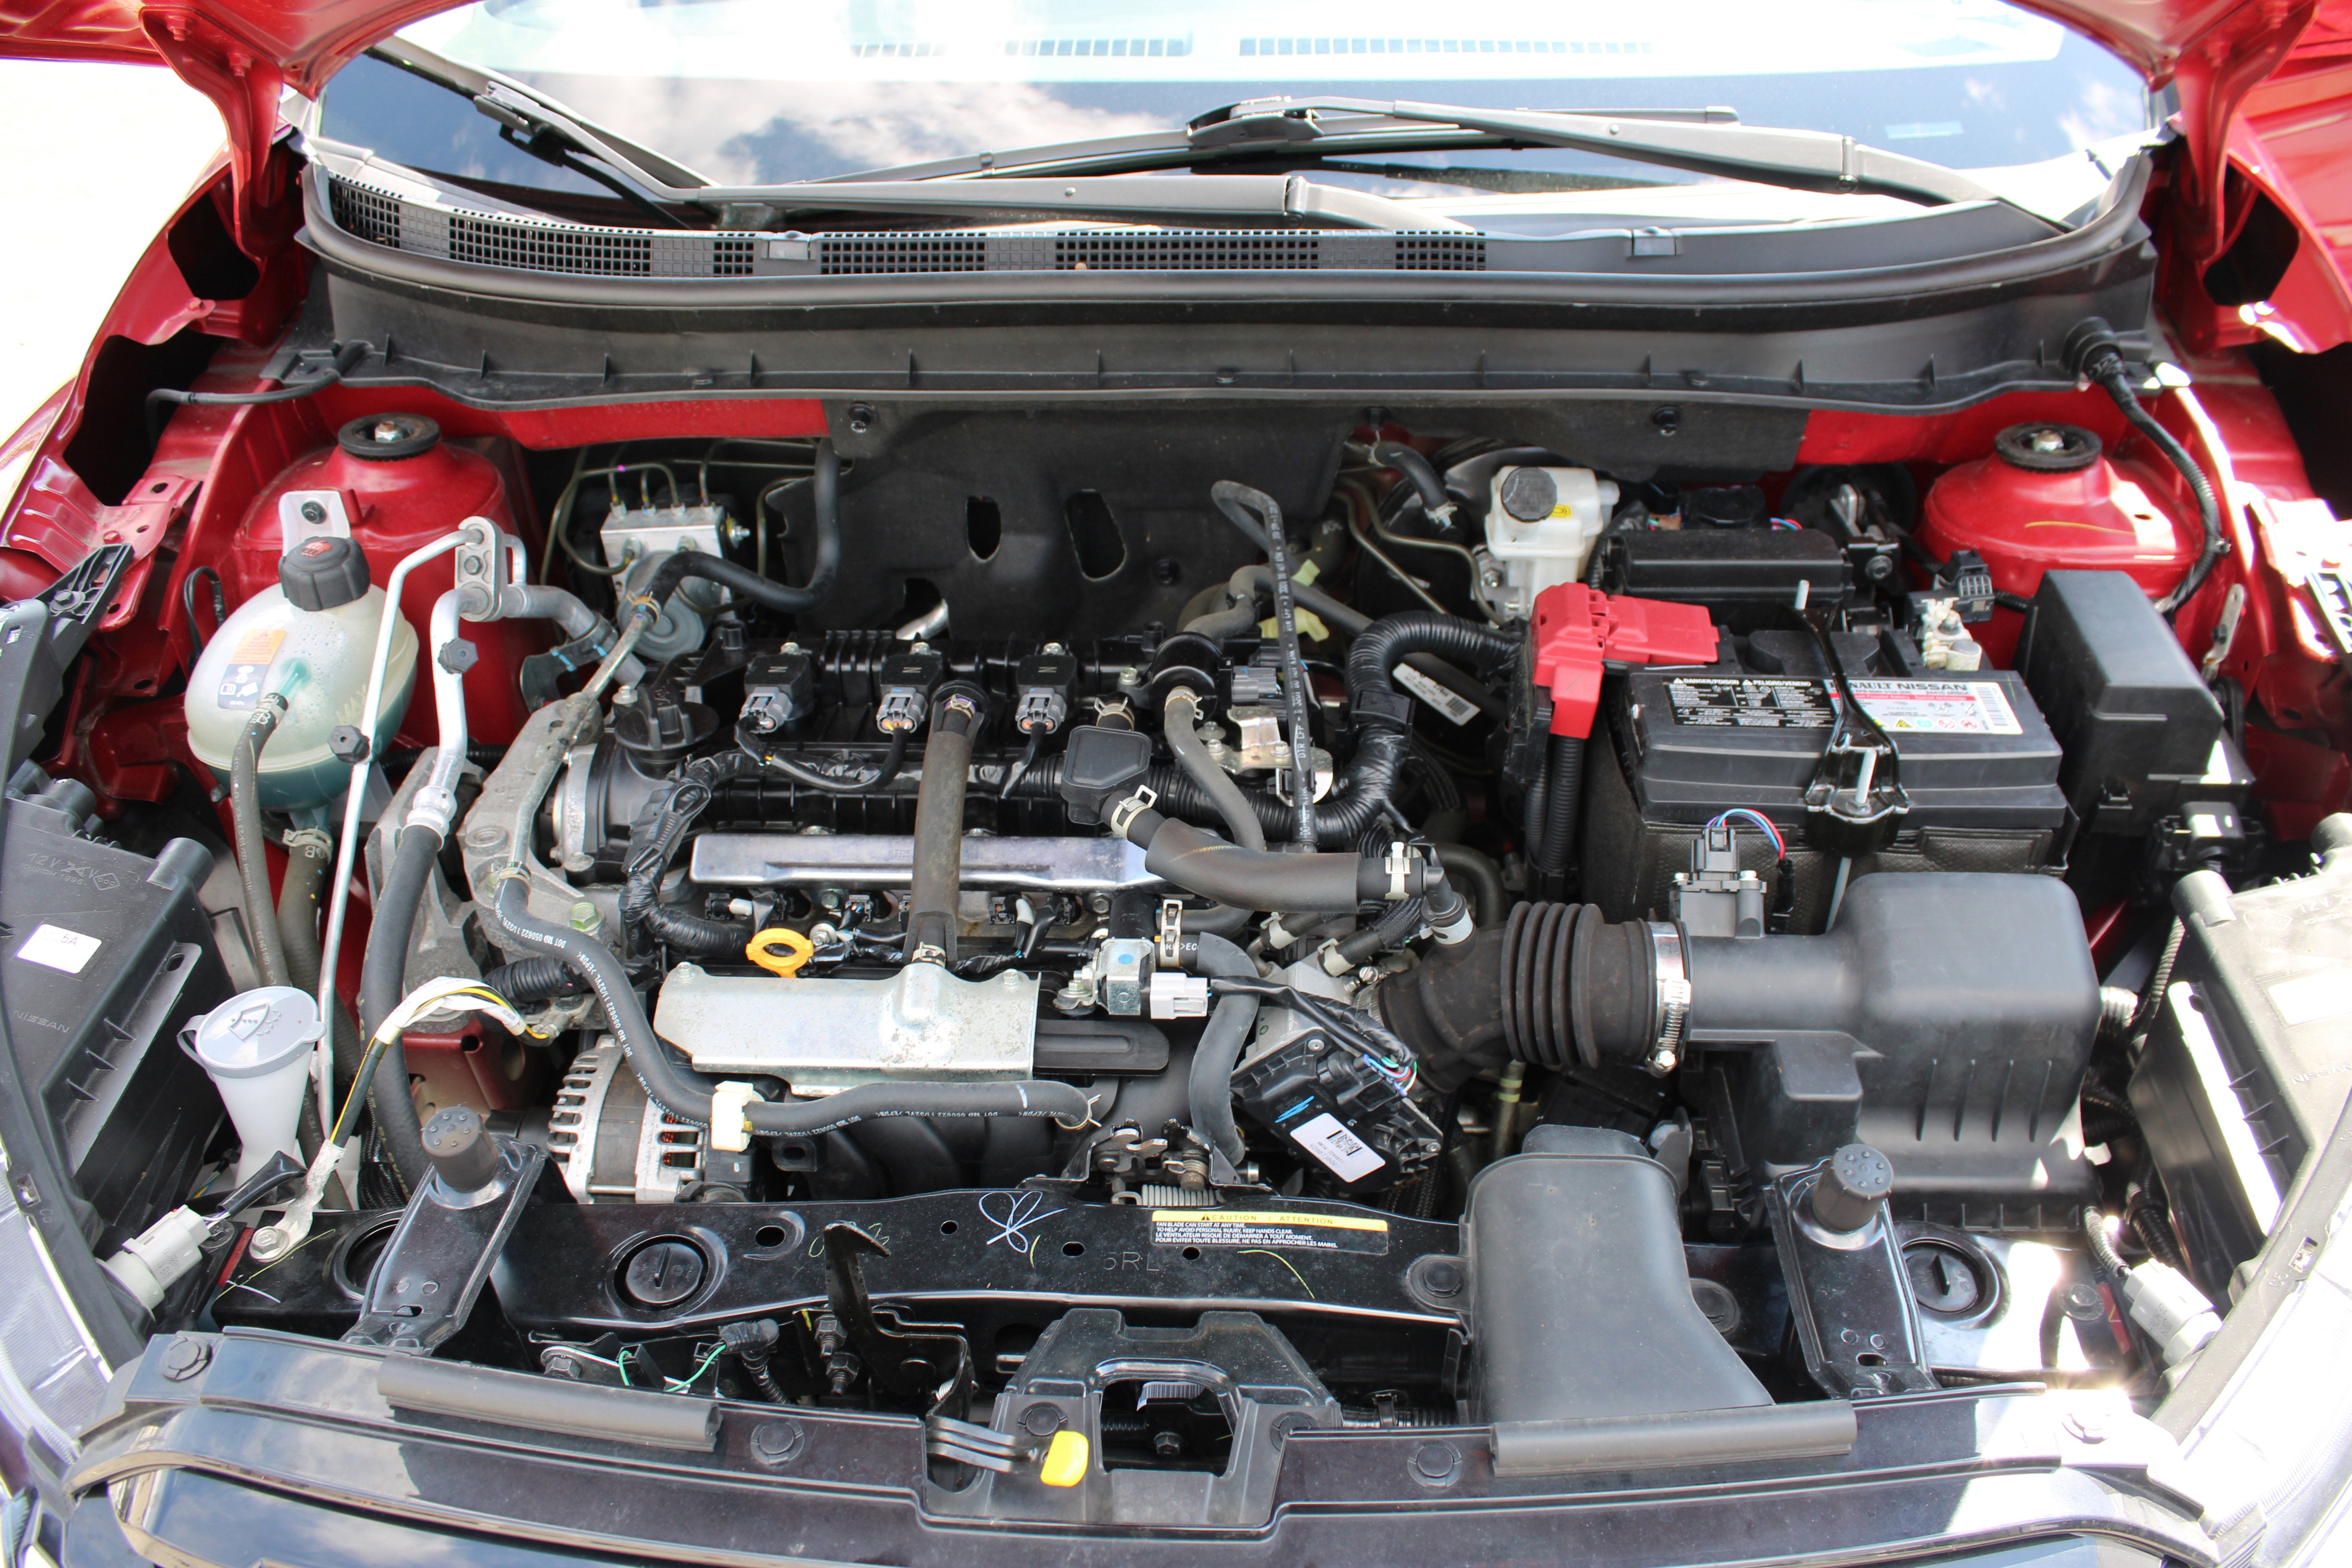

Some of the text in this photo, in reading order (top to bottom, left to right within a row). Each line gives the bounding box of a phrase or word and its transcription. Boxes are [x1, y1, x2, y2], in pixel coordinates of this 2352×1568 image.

[554, 939, 568, 949] DOT
[14, 1011, 71, 1033] NISSAN
[623, 1044, 633, 1057] DOT
[1279, 1216, 1333, 1225] ATTENTION
